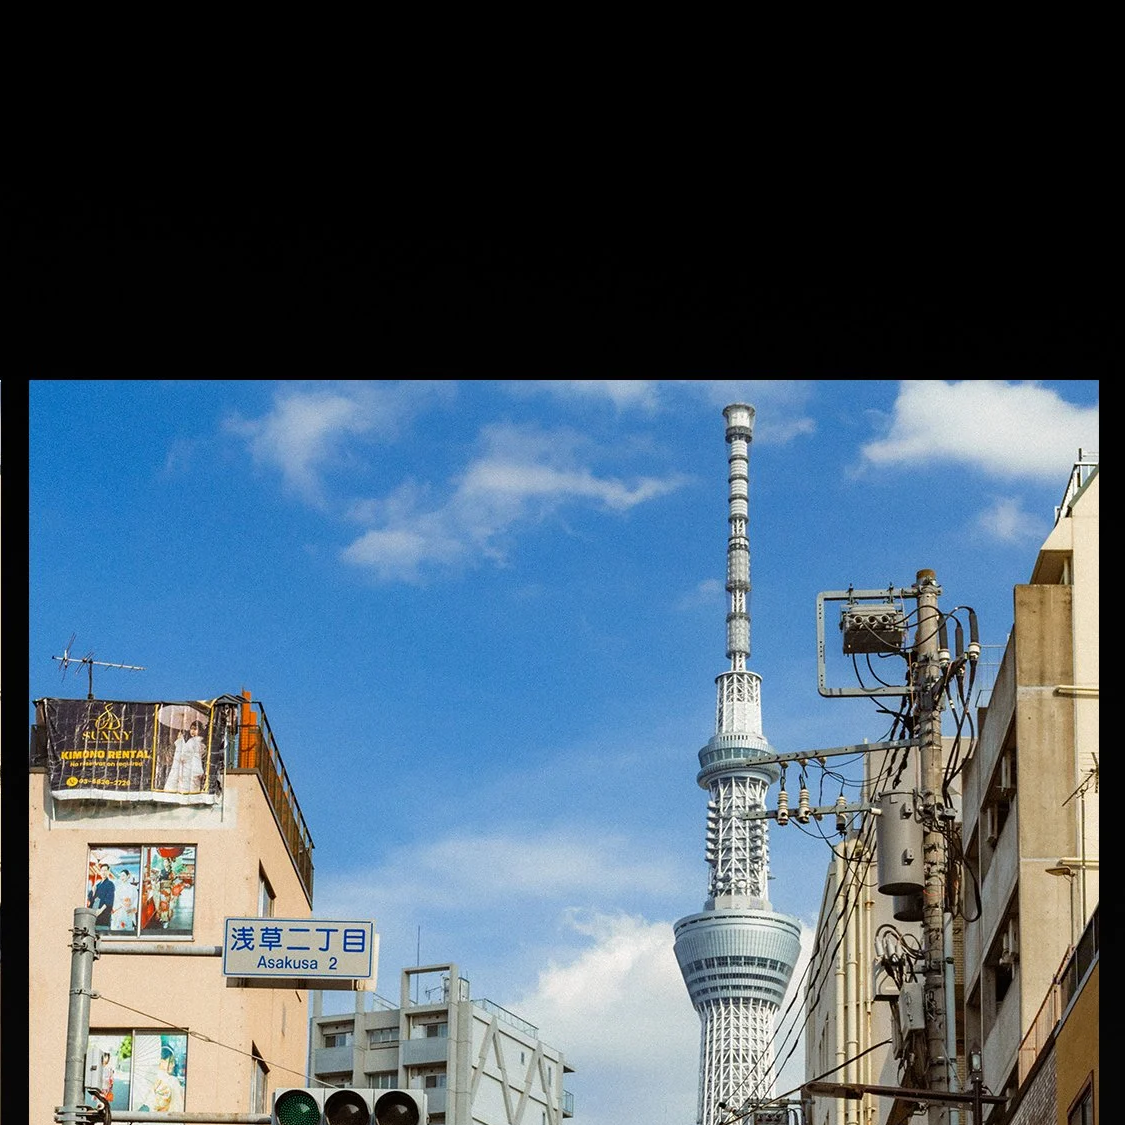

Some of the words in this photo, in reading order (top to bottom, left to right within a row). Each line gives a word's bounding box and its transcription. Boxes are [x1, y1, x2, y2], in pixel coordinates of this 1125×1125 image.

[82, 730, 132, 740] SUNNY
[61, 751, 105, 760] KIMONO
[107, 750, 150, 758] RENTAL
[231, 926, 365, 952] 浅草二丁目
[257, 956, 318, 970] Asakusa
[329, 956, 337, 970] 2
